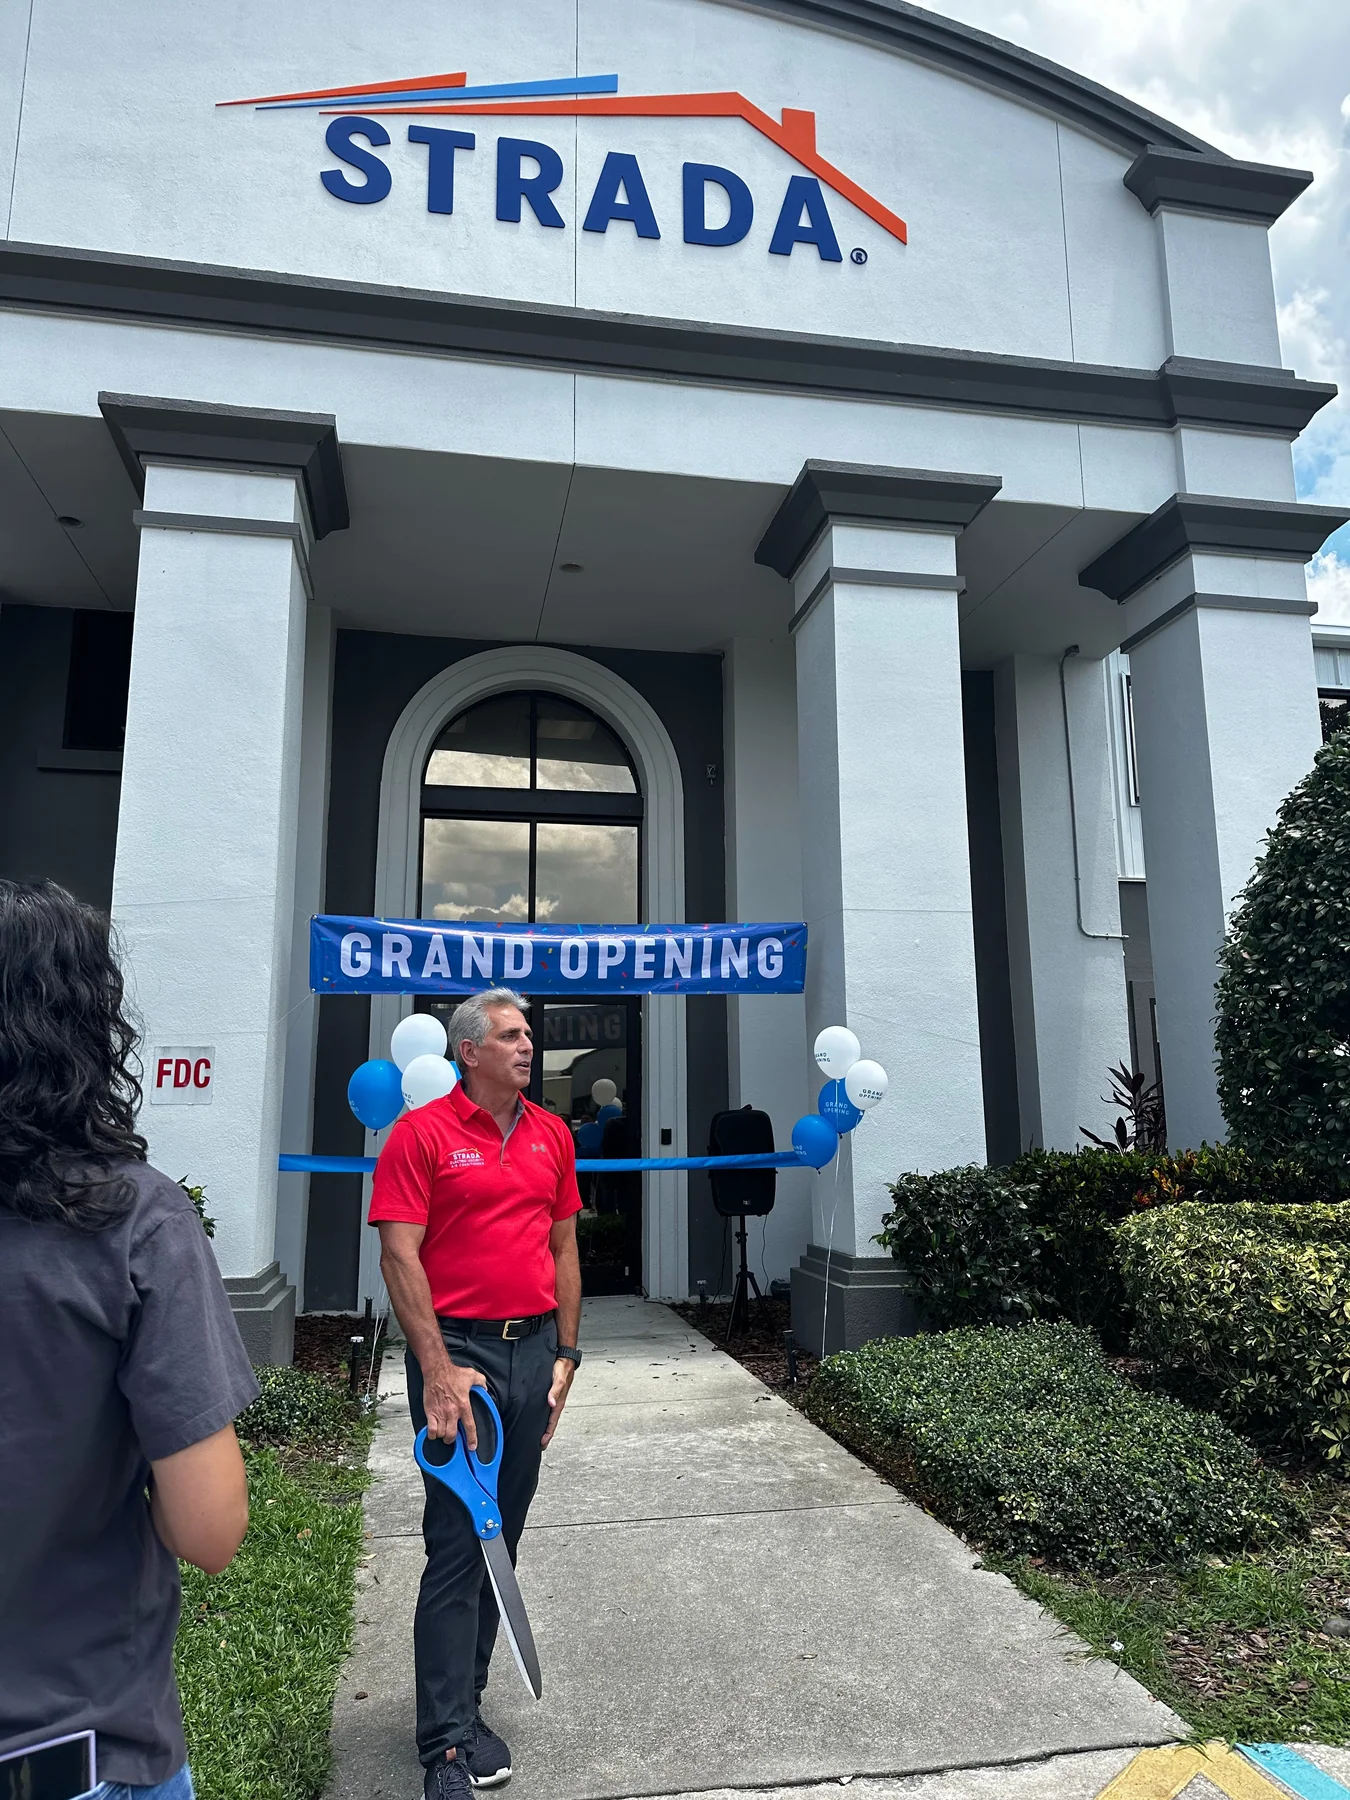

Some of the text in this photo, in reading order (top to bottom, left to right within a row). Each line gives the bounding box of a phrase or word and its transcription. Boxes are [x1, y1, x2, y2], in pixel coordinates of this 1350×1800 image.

[320, 115, 843, 263] STRADA
[339, 932, 784, 980] GRAND OPENING
[155, 1057, 211, 1089] FDC
[823, 1107, 850, 1115] OPENING
[825, 1101, 848, 1109] GRAND
[452, 1152, 481, 1160] STRADA
